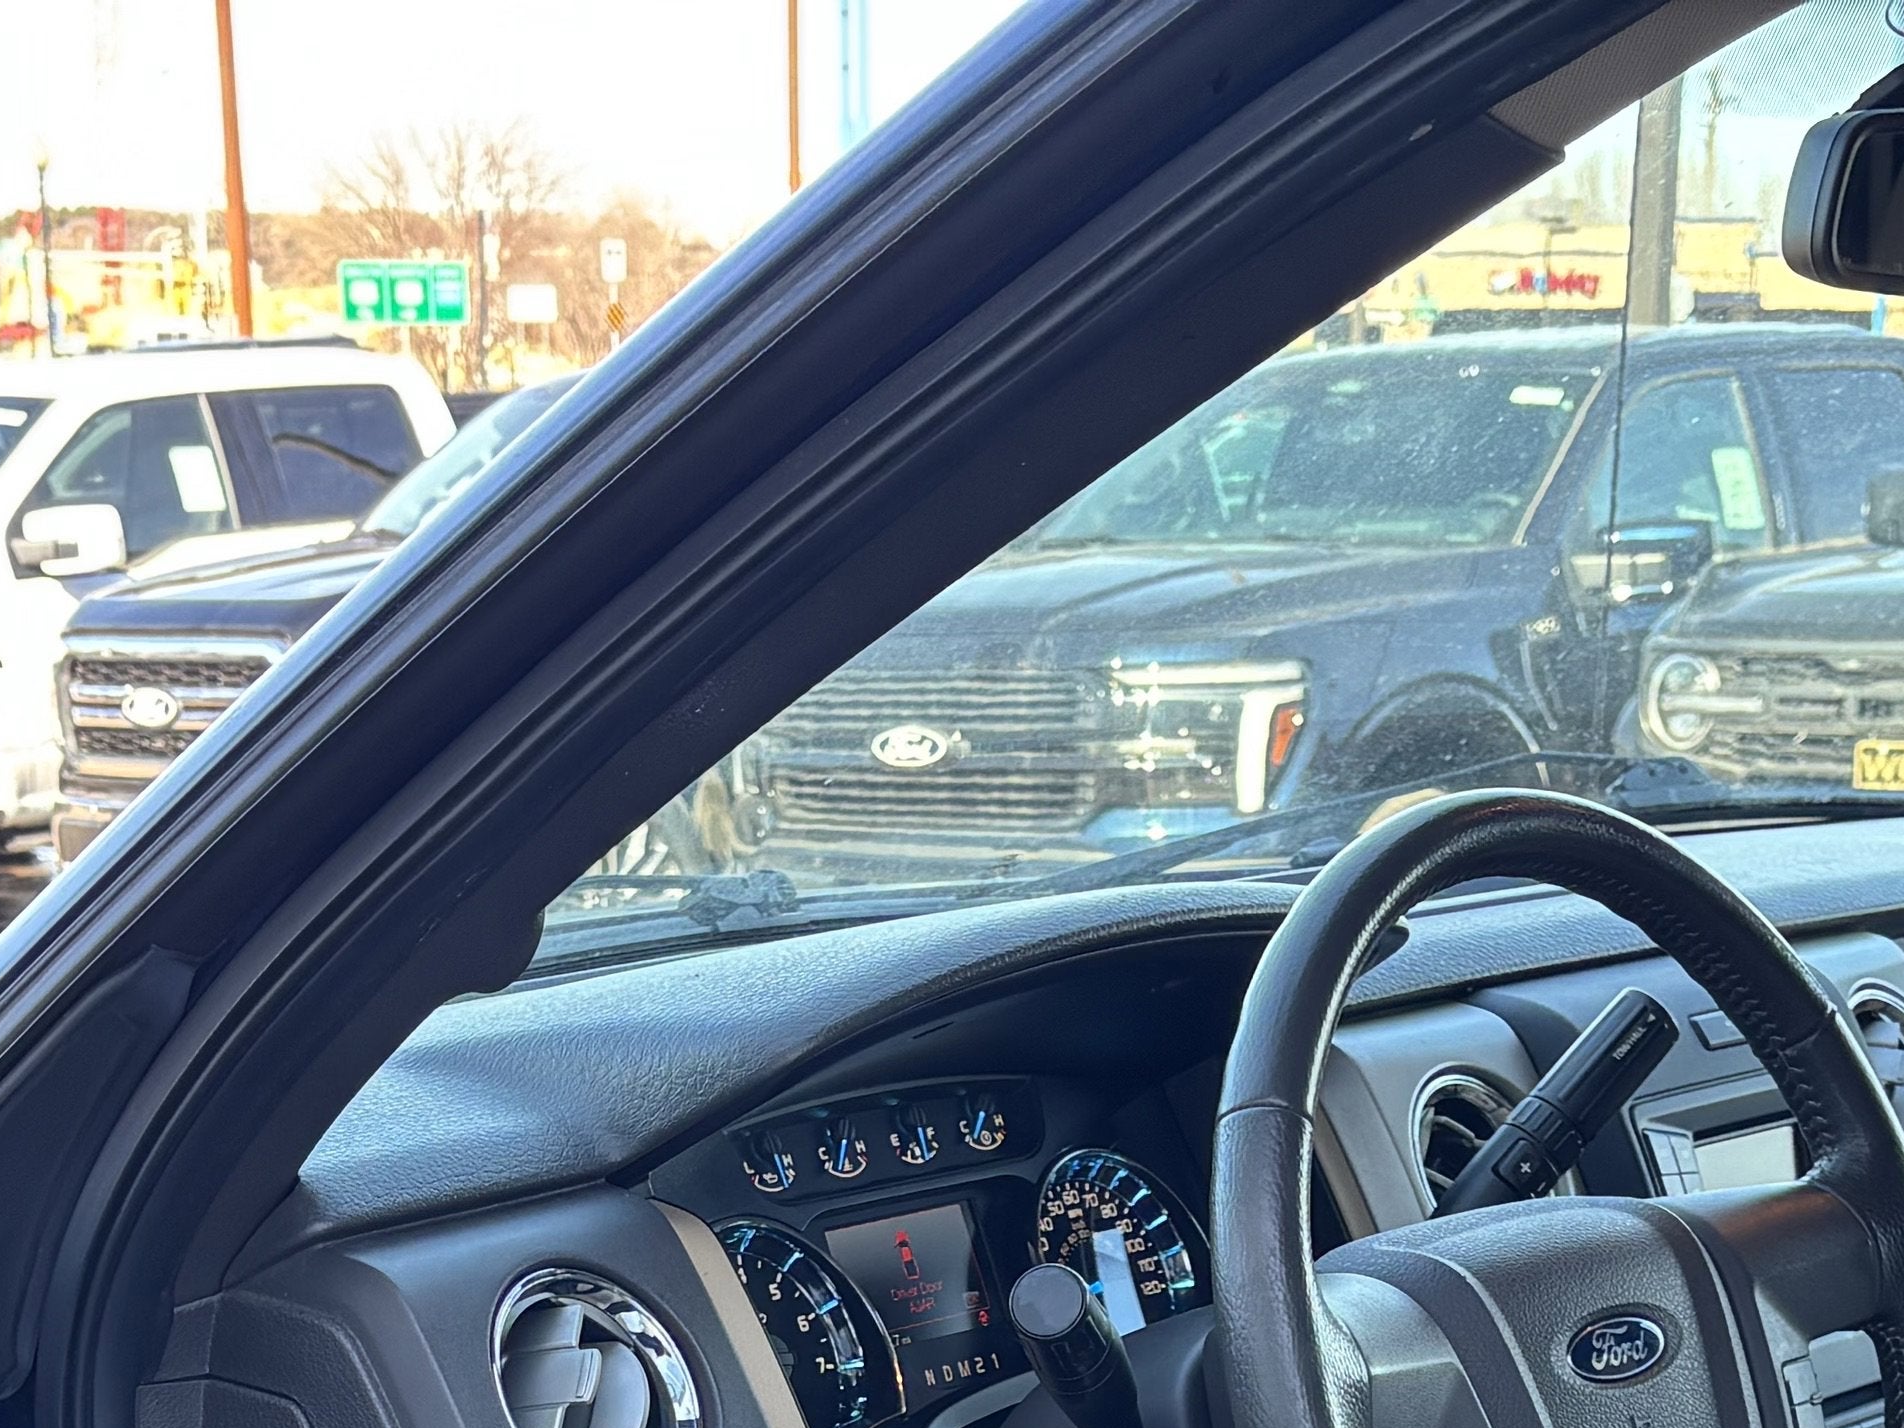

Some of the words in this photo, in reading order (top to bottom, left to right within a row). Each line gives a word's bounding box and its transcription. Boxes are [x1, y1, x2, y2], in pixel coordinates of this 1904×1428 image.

[959, 1120, 969, 1133] C
[993, 1113, 1004, 1126] H
[890, 1133, 901, 1147] E
[926, 1126, 936, 1140] F
[818, 1146, 828, 1160] C
[855, 1140, 866, 1152] H
[744, 1161, 754, 1174] L
[782, 1154, 794, 1166] H
[1062, 1190, 1080, 1205] 60
[1082, 1192, 1099, 1208] 70
[1047, 1200, 1065, 1216] 50
[1100, 1203, 1117, 1219] 80
[768, 1283, 782, 1301] 5
[797, 1315, 810, 1332] 6
[1591, 1325, 1649, 1371] Ford
[815, 1357, 826, 1374] 7
